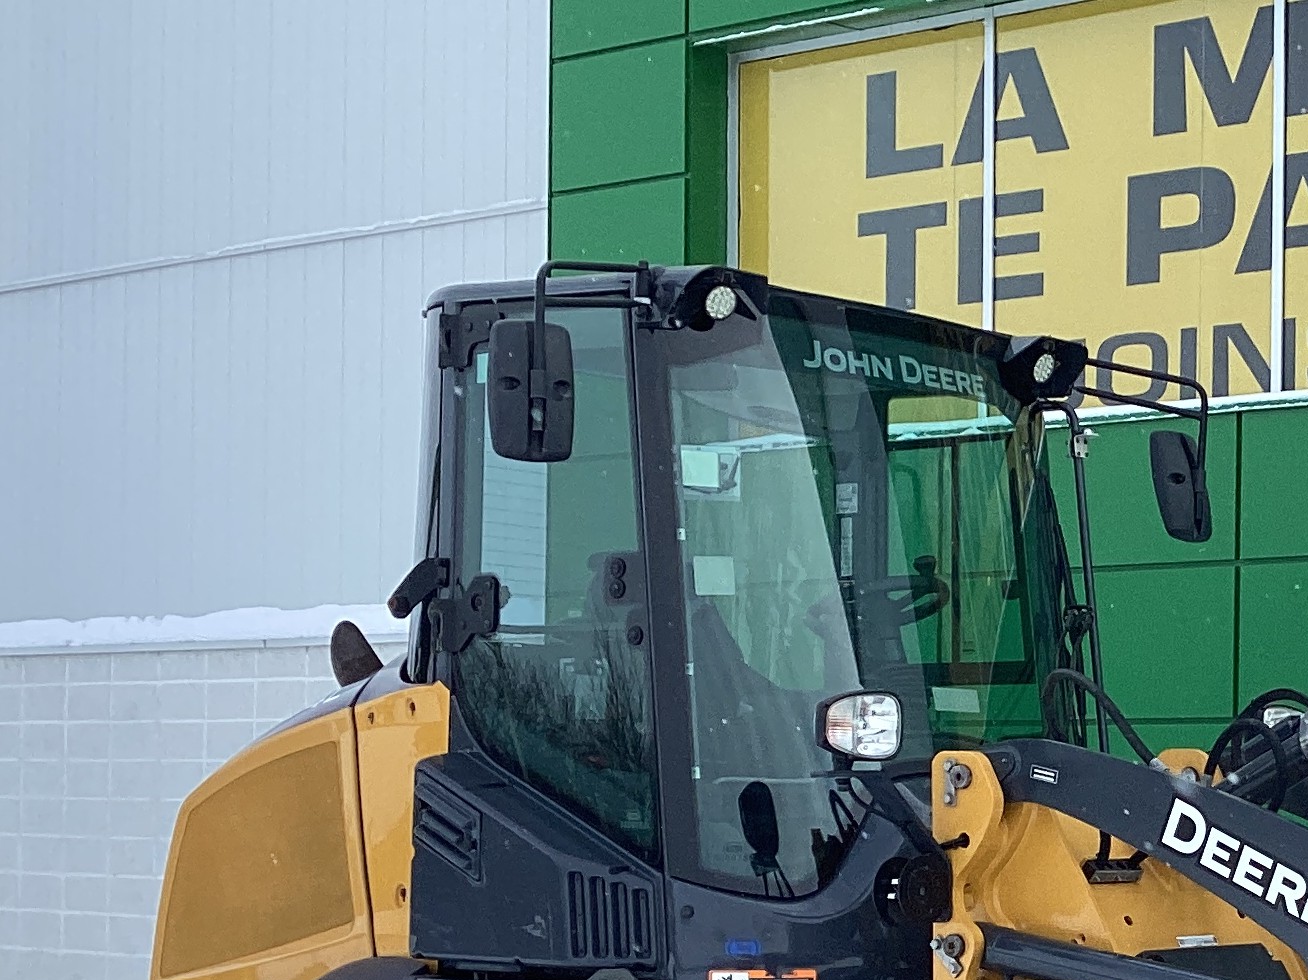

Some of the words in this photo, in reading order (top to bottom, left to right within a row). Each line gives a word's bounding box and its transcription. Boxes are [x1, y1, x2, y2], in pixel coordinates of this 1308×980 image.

[865, 47, 1069, 179] LA
[857, 189, 1044, 310] TE
[803, 340, 893, 381] JOHN
[899, 355, 986, 398] DEERE
